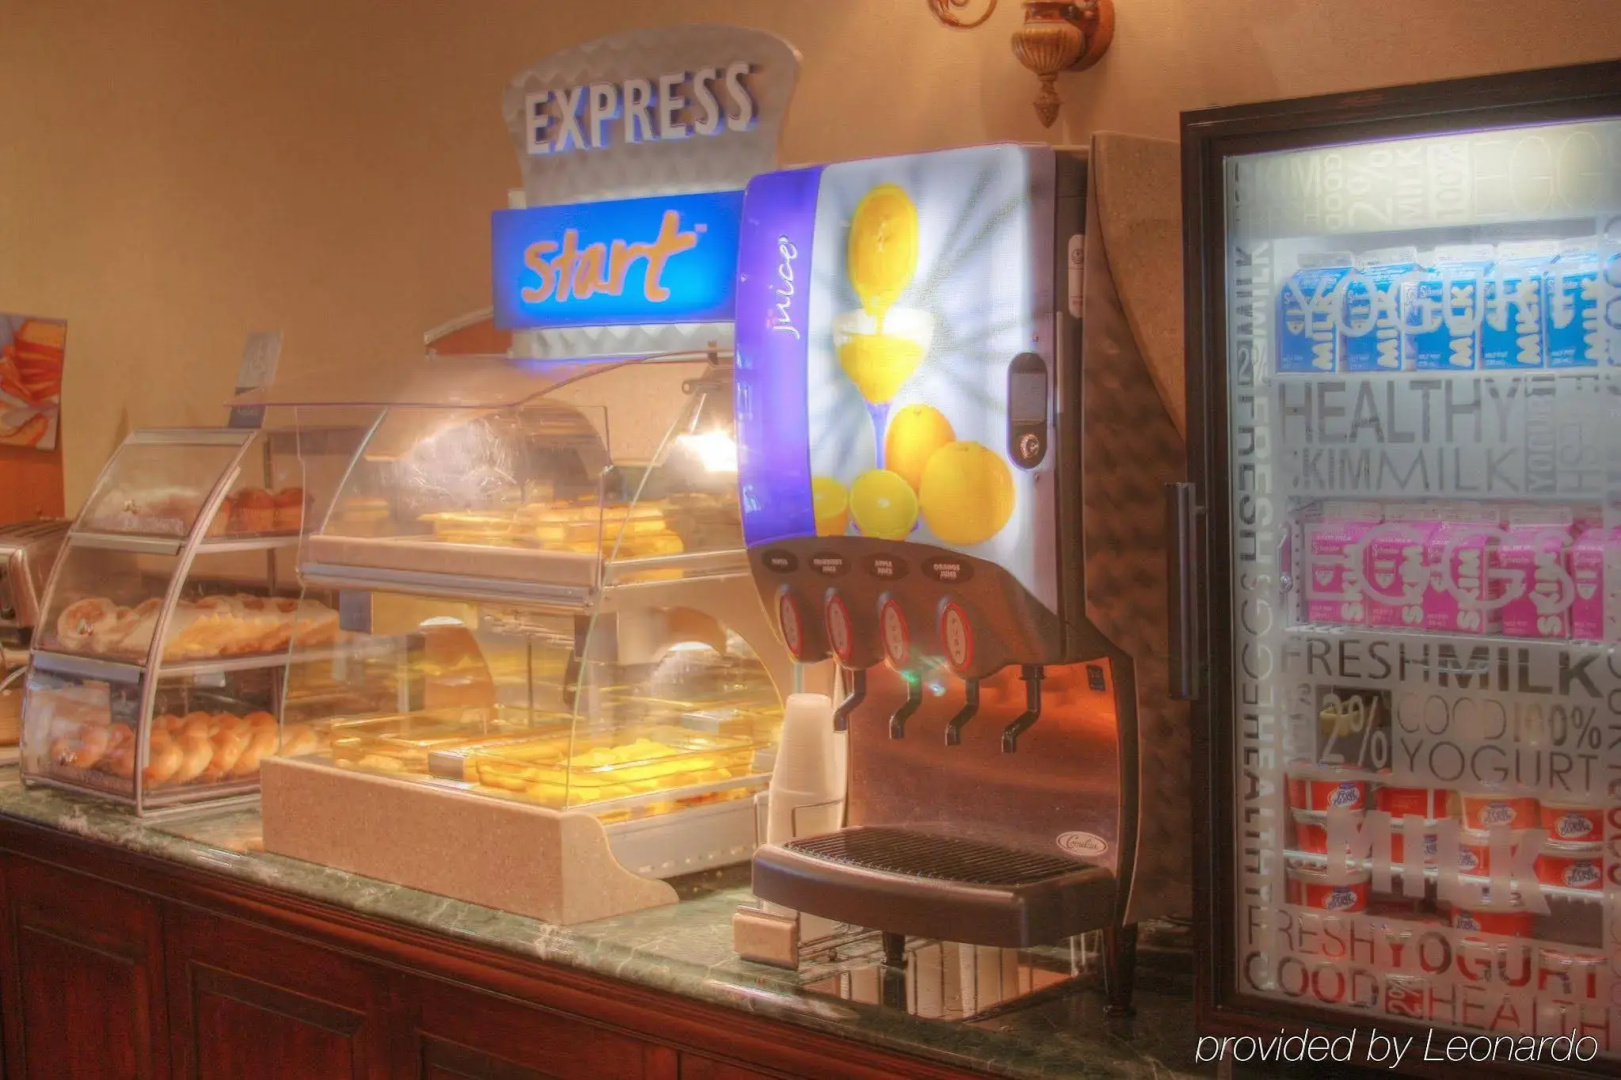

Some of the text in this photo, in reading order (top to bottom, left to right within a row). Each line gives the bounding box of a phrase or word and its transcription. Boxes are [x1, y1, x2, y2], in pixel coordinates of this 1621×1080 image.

[525, 61, 754, 155] EXPRESS
[768, 238, 799, 340] juice
[1235, 242, 1270, 336] MILK
[1278, 376, 1524, 445] HEALTHY
[1305, 523, 1576, 614] EGGS
[1320, 690, 1387, 768] 2%
[1400, 737, 1599, 792] YOGURT
[1327, 806, 1552, 915] MILK
